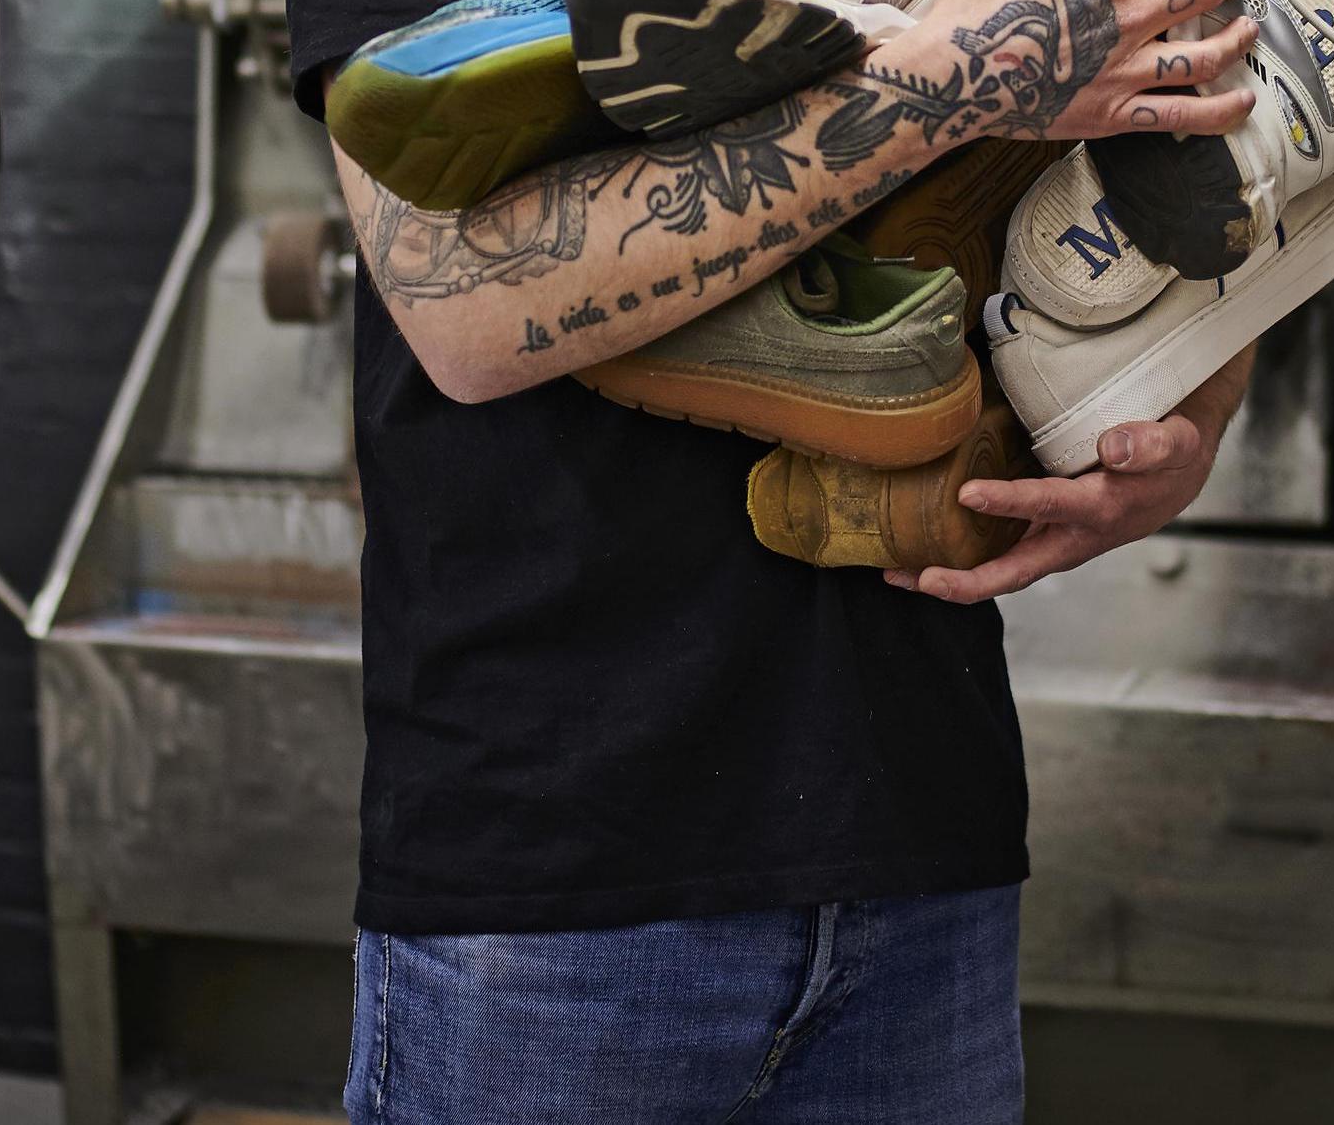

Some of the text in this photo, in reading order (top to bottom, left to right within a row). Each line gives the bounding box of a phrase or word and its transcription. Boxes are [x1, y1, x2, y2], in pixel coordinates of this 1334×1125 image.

[559, 296, 610, 334] vida
[617, 291, 641, 311] es
[652, 275, 683, 298] un
